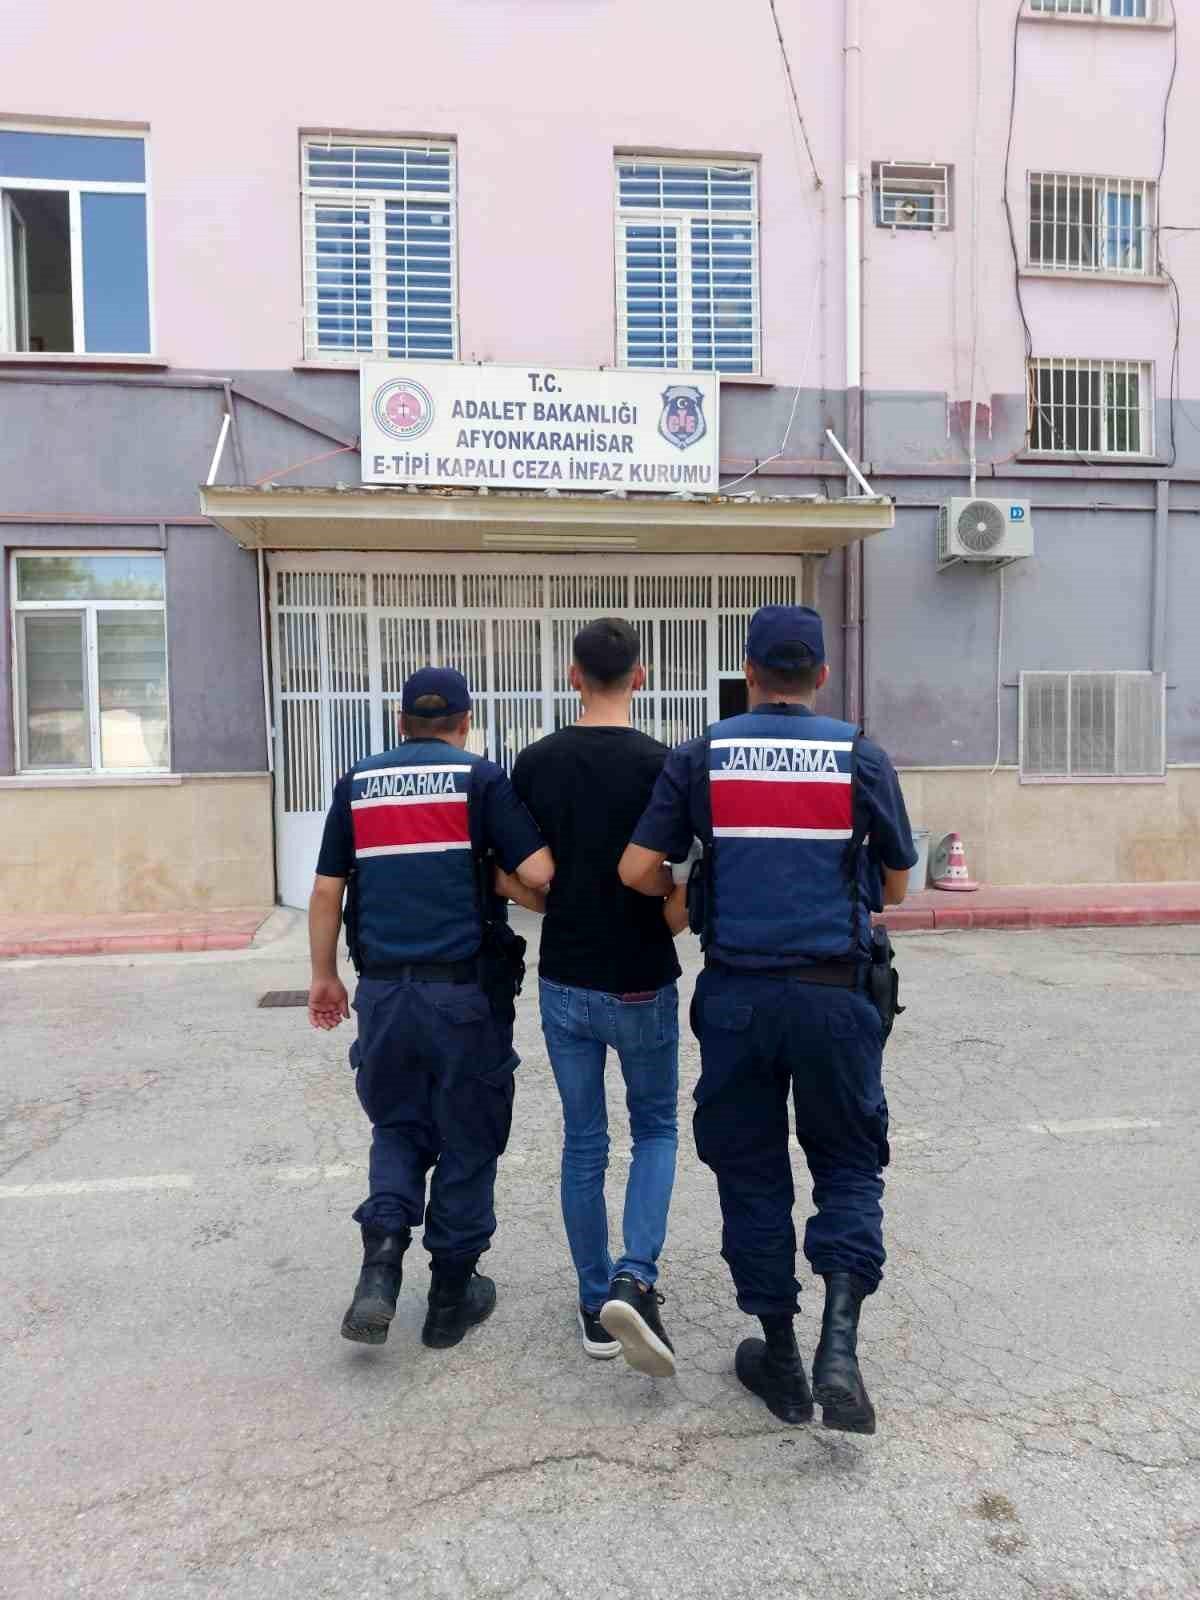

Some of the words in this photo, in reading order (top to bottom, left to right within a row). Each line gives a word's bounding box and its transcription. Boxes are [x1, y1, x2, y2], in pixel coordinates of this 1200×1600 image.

[528, 374, 562, 392] T.C.
[452, 400, 528, 421] ADALET
[534, 402, 637, 425] BAKANLIĞI
[457, 428, 633, 454] AFYONKARAHİSAR
[373, 453, 430, 475] E-TİPİ
[437, 456, 506, 479] KAPALI
[513, 460, 562, 480] CEZA
[570, 457, 623, 482] İNFAZ
[630, 463, 711, 484] KURUMU
[722, 745, 839, 773] JANDARMA
[361, 772, 456, 799] JANDARMA
